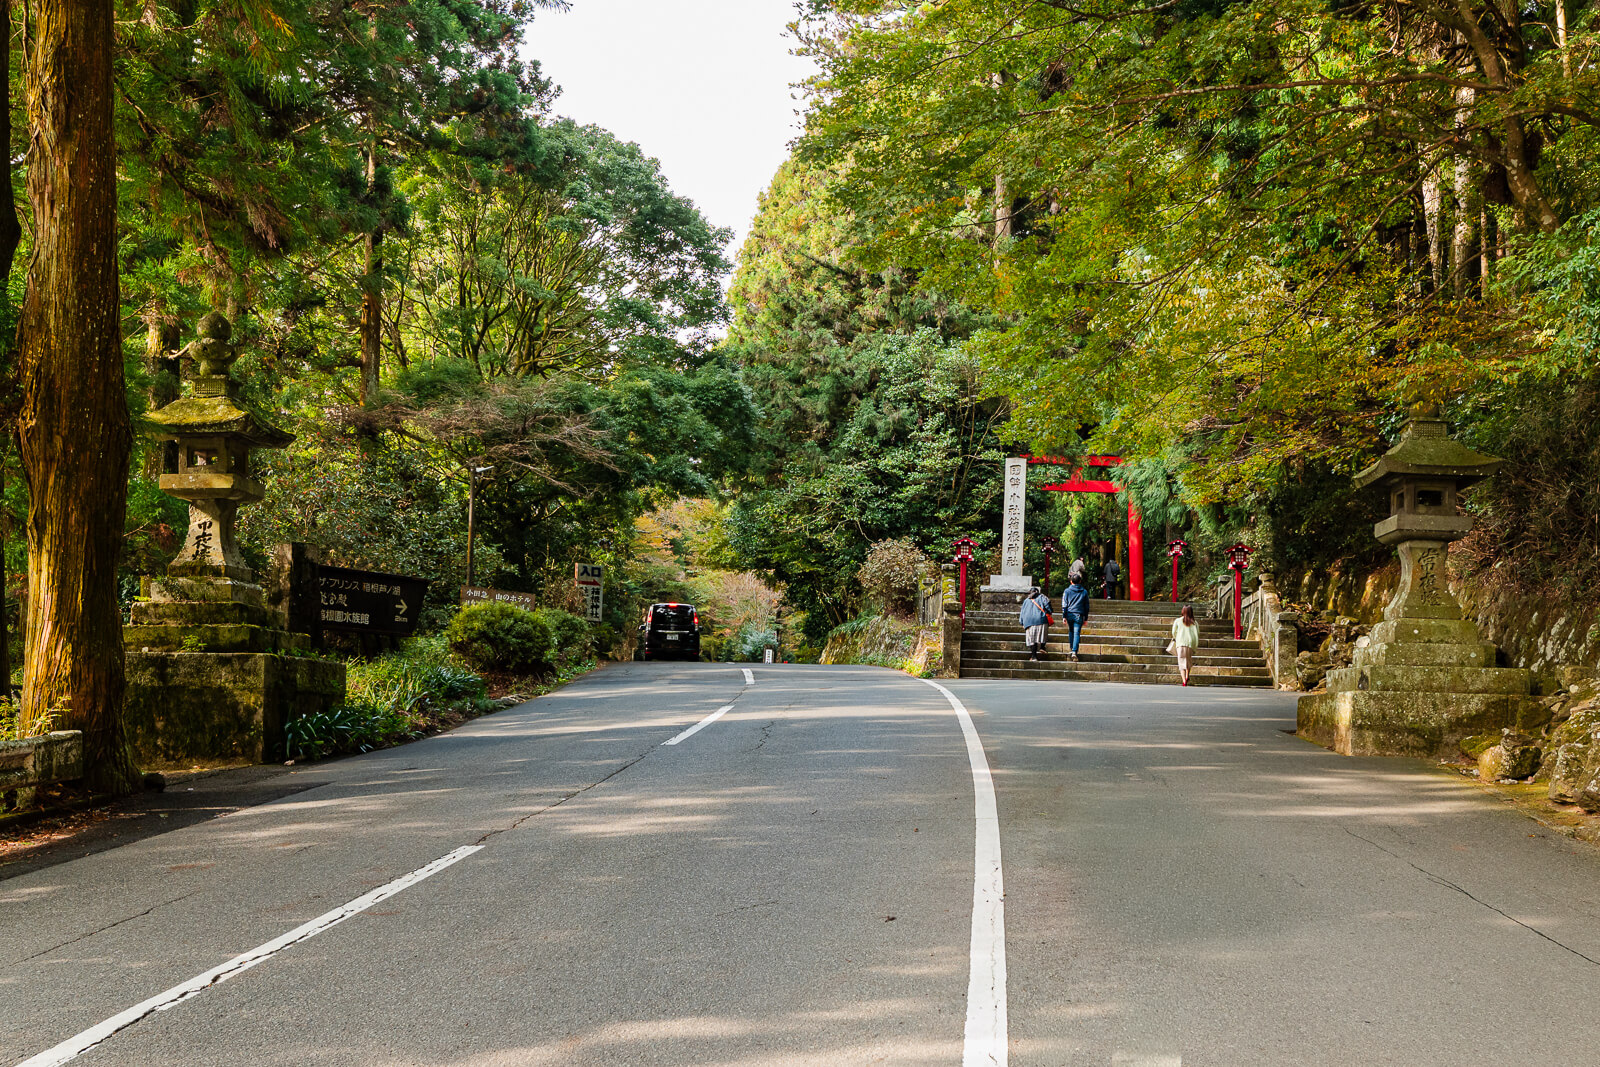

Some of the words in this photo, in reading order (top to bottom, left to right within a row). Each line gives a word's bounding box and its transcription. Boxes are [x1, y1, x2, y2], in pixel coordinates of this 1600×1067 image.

[580, 566, 602, 577] 入口
[495, 593, 531, 603] 山のホテル
